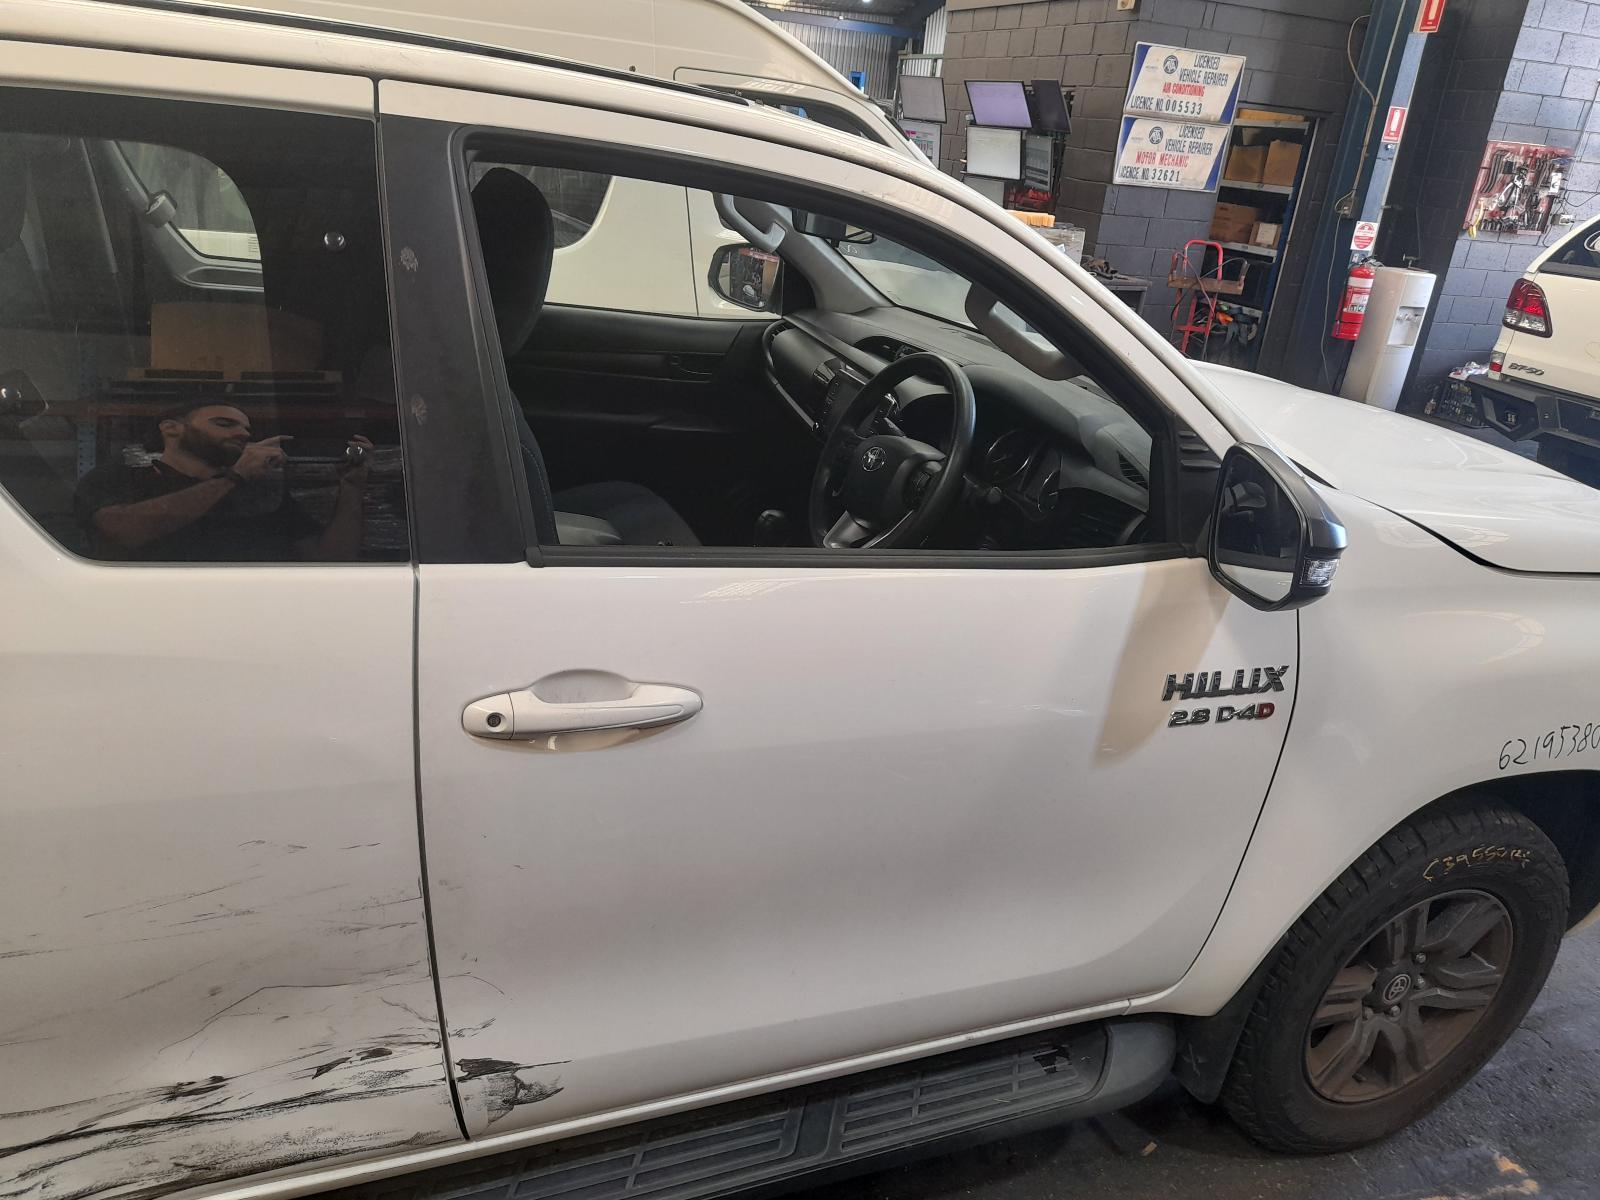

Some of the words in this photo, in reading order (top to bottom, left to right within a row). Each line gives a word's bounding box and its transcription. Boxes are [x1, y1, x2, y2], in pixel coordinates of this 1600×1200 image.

[1194, 54, 1221, 70] LICENSED
[1179, 68, 1202, 83] VEHICLE
[1203, 71, 1229, 87] REPAIRER
[1162, 82, 1171, 94] AIR
[1172, 83, 1206, 97] CONDITIONING
[1130, 95, 1154, 110] LICENCE
[1165, 99, 1203, 115] 005533
[1179, 124, 1206, 140] LICENSED
[1165, 138, 1187, 153] VEHICLE
[1188, 141, 1213, 156] REPAIRER
[1135, 151, 1157, 164] MOTOR
[1158, 153, 1190, 168] MECHANIC
[1151, 169, 1180, 183] 32621
[1161, 665, 1290, 701] HILUX
[1215, 702, 1275, 723] D-4D
